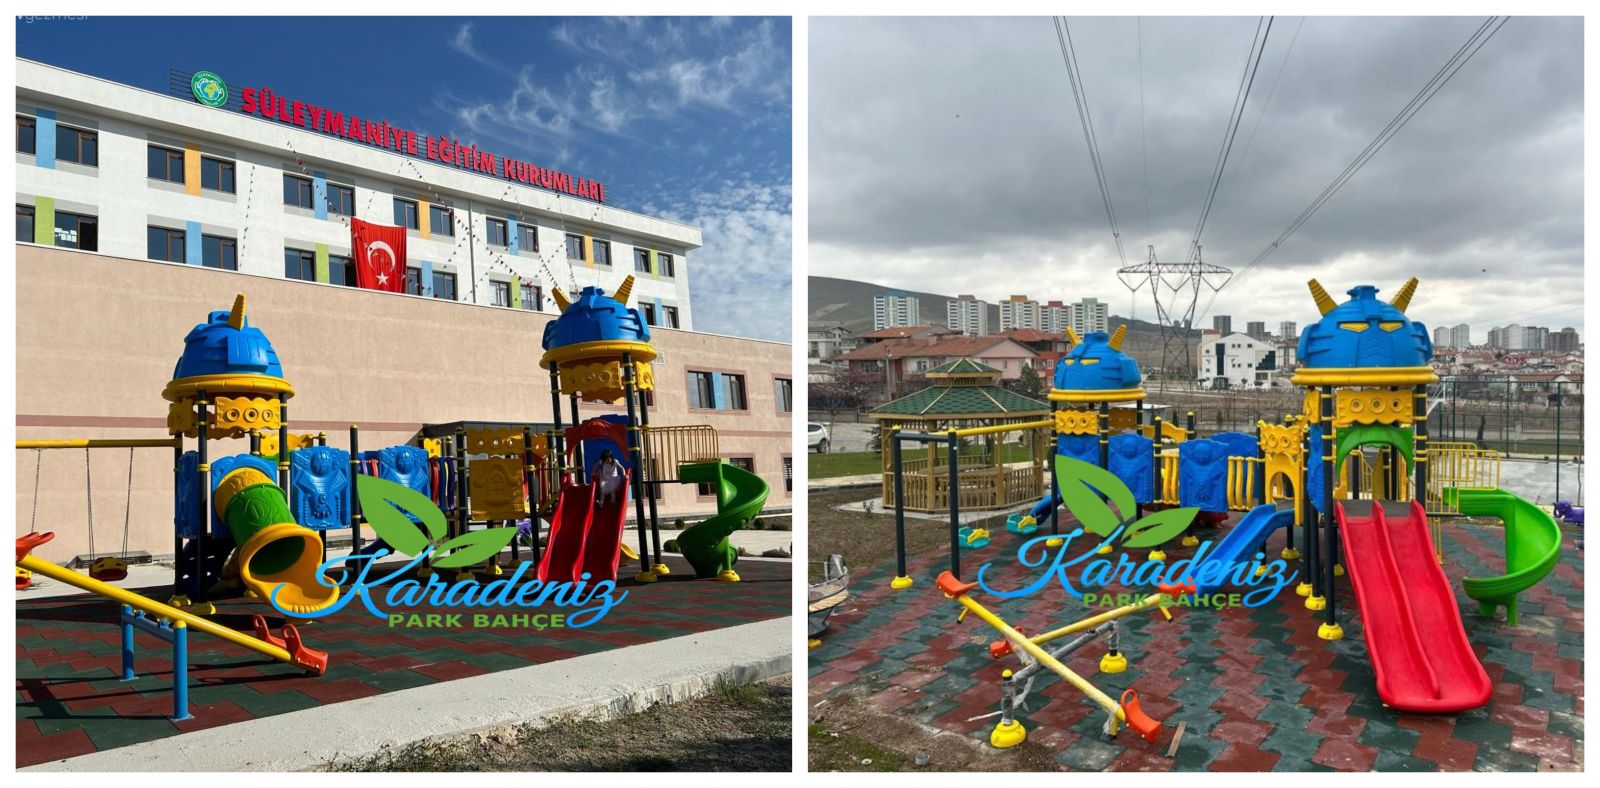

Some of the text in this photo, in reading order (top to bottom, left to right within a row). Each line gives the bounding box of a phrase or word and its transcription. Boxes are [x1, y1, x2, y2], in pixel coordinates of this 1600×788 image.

[241, 87, 604, 201] SÜLEYMANİYE EĞİTİM KURUMLARI
